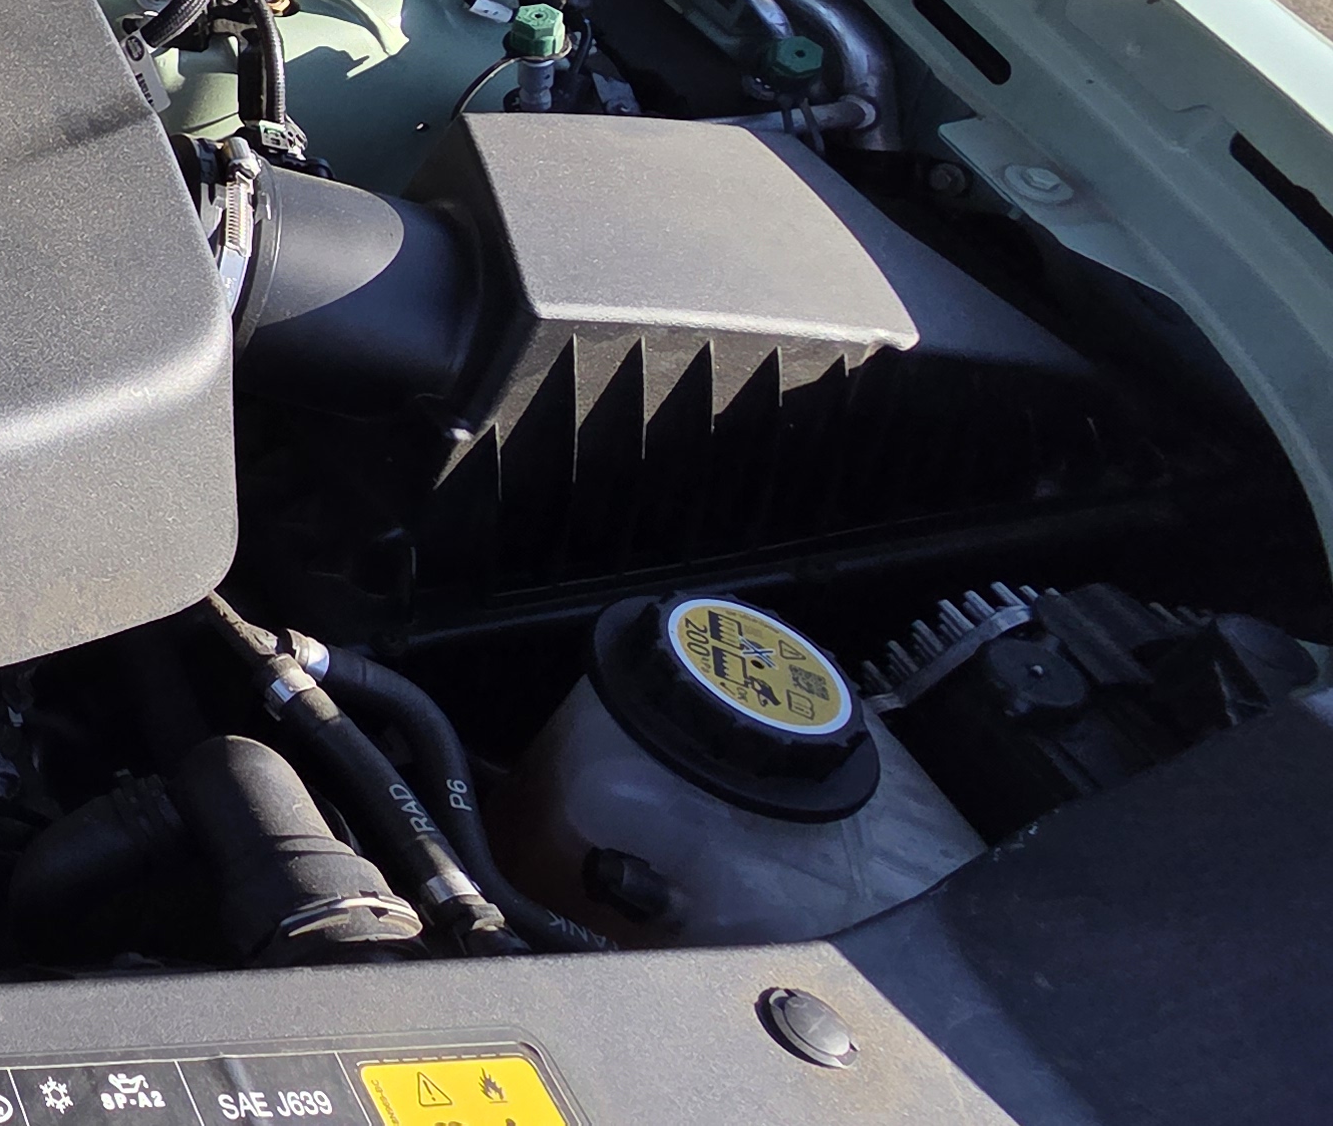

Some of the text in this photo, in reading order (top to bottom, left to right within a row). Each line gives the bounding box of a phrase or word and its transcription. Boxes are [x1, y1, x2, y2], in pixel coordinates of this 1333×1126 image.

[685, 618, 710, 658] 200
[389, 783, 435, 832] RAD
[446, 779, 472, 812] P6
[100, 1091, 167, 1111] SP-A2
[219, 1089, 333, 1120] SAE J639
